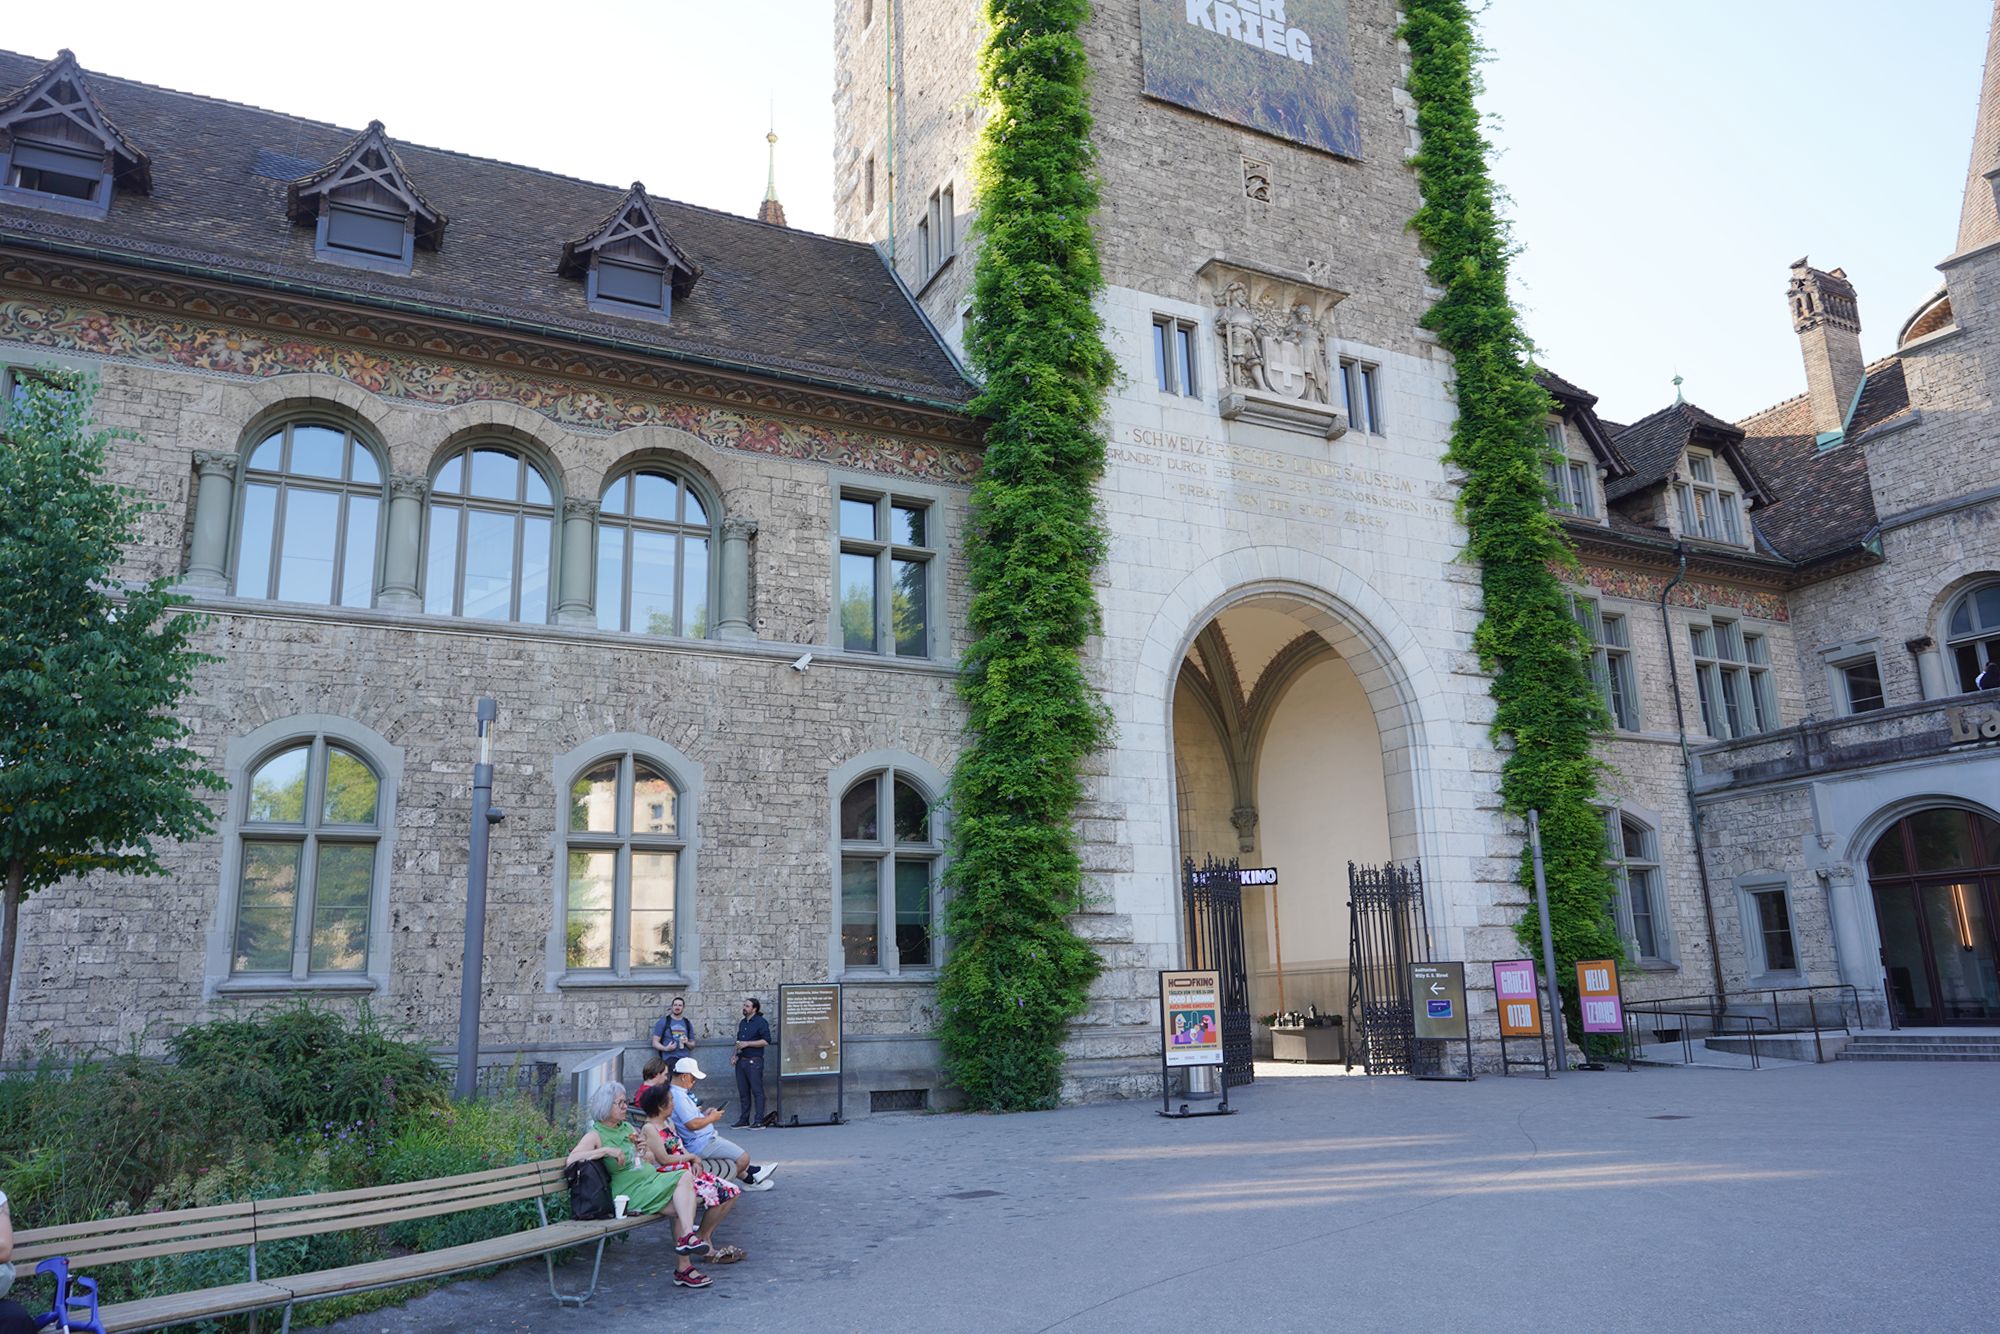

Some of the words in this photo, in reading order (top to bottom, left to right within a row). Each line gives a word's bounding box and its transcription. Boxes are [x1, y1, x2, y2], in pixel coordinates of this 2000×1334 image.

[1186, 0, 1312, 65] KRIEG
[1132, 428, 1285, 468] SCHWEIZERISCHES
[1167, 458, 1207, 476] DURCH
[1168, 978, 1214, 988] HOFKINO
[1584, 969, 1609, 992] HELLO
